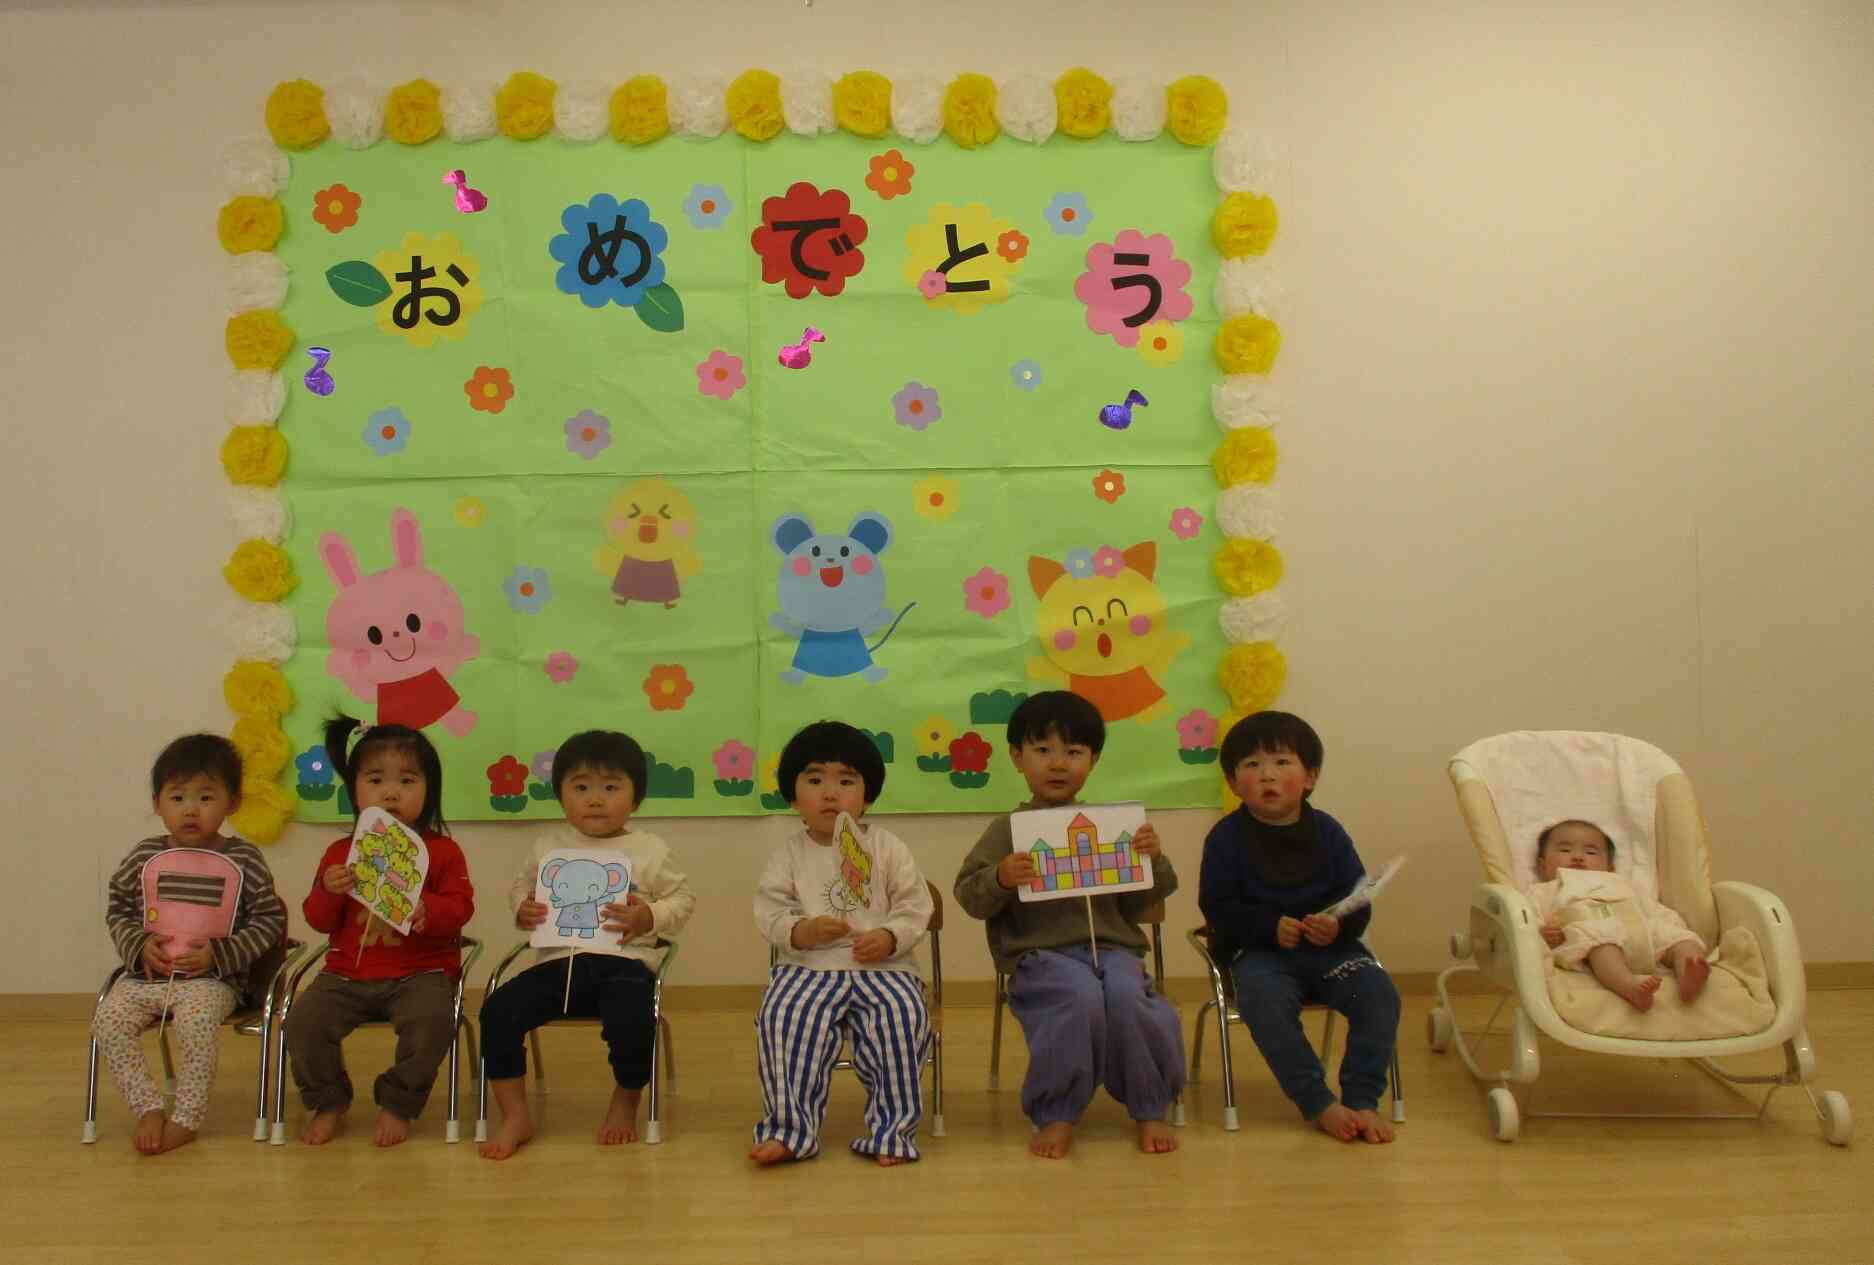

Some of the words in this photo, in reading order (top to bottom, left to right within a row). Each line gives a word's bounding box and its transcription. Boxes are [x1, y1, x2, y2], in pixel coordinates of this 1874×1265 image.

[392, 214, 1163, 329] おめでとう
